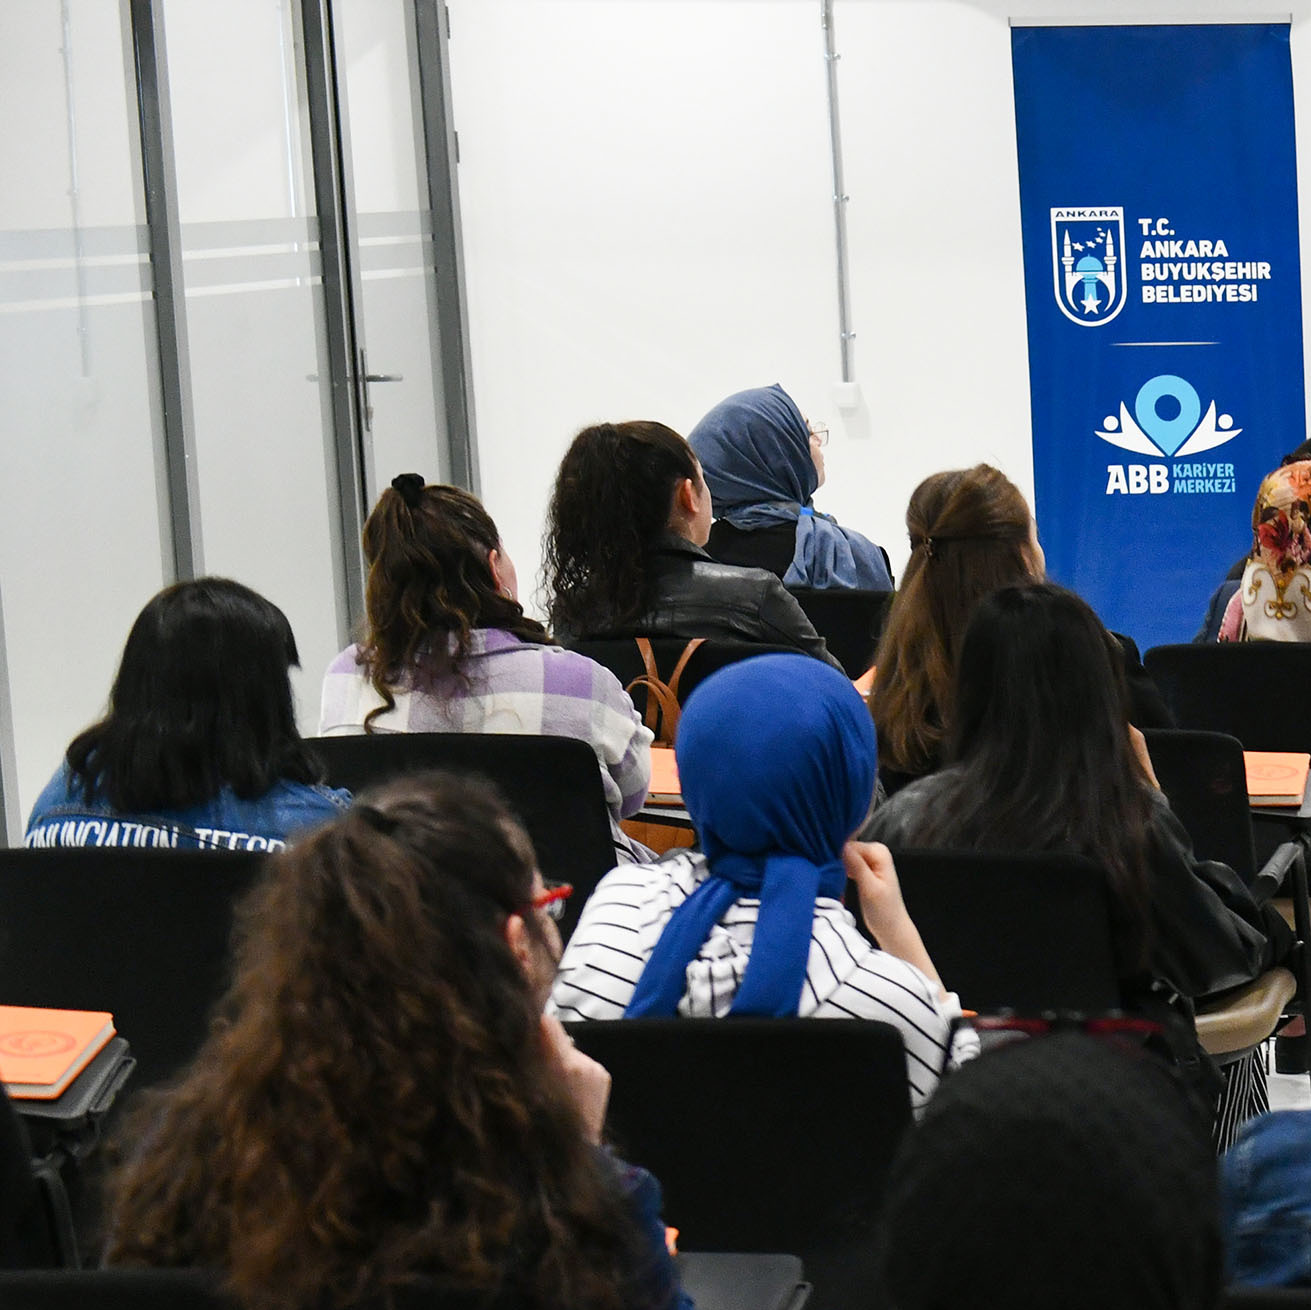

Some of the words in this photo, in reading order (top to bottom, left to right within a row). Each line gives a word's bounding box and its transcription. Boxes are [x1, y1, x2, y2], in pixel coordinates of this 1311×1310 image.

[1055, 208, 1119, 218] ANKARA
[1138, 218, 1175, 236] T.C.
[1140, 240, 1229, 258] ANKARA
[1105, 464, 1170, 495] ABB
